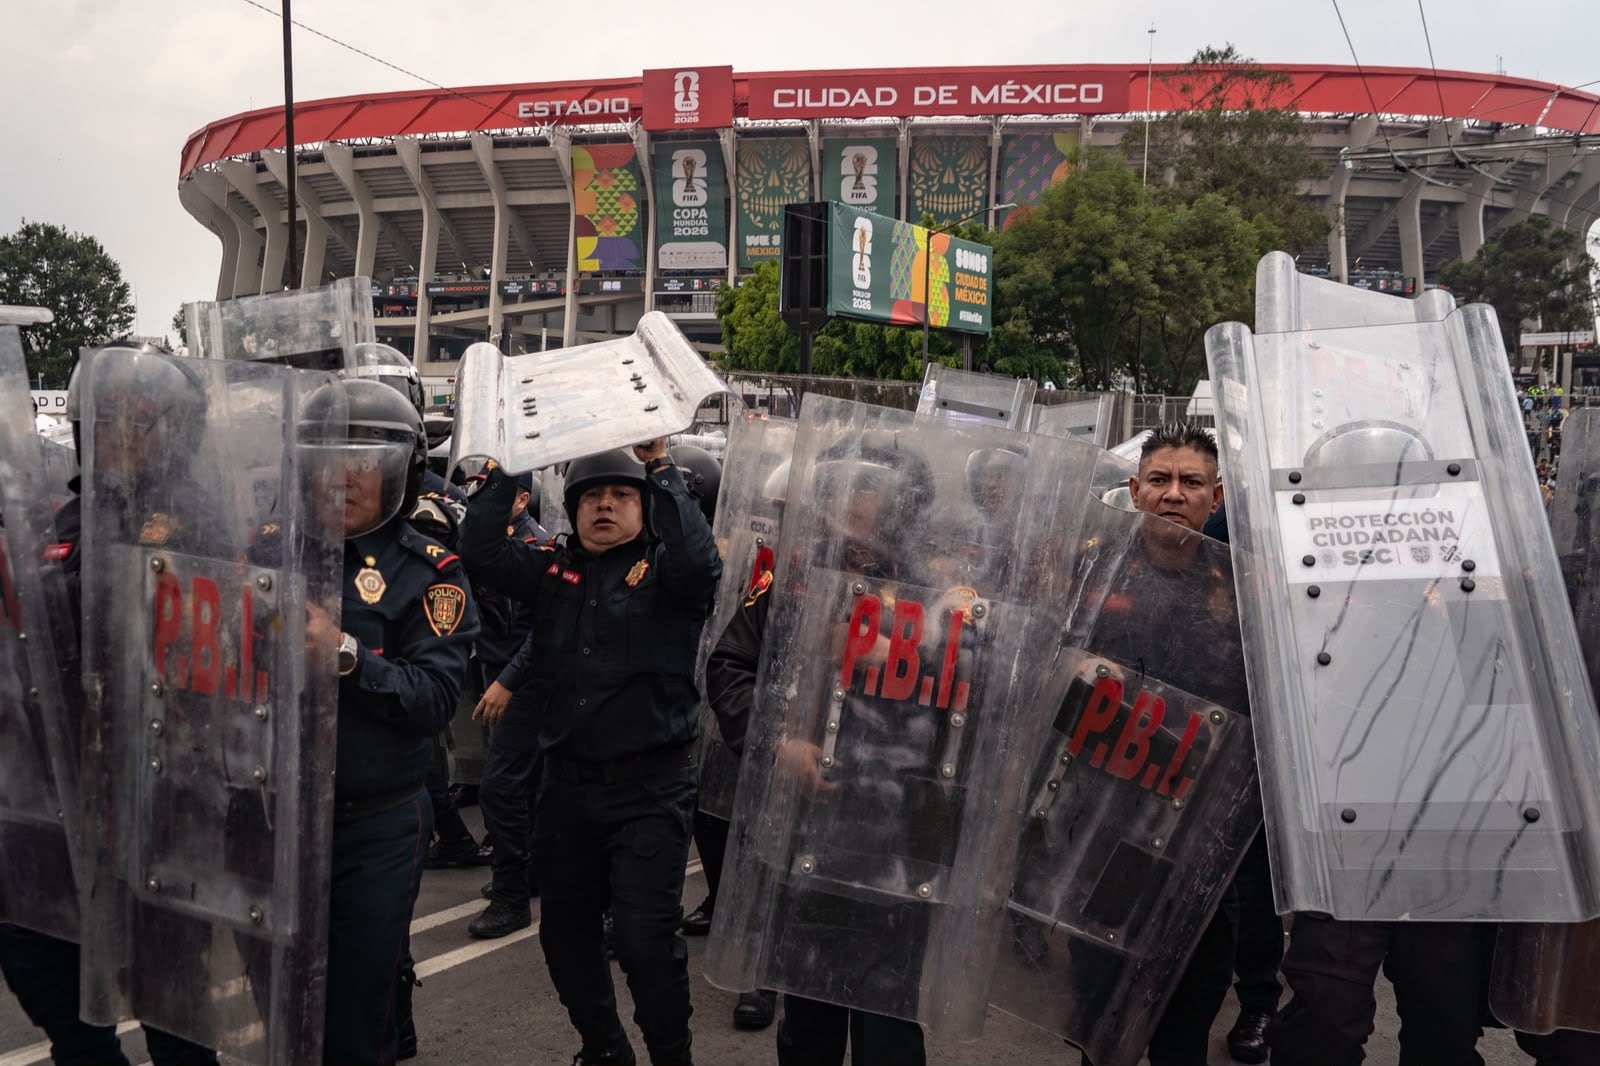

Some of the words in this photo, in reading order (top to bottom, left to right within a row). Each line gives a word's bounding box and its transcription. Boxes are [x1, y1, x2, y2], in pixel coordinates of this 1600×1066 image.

[773, 86, 897, 108] CIUDAD
[914, 86, 958, 106] DE
[970, 80, 1104, 104] MÉXICO
[518, 98, 630, 118] ESTADIO
[673, 208, 708, 219] COPA
[674, 227, 709, 236] 2026
[746, 248, 780, 256] MEXICO
[955, 272, 979, 289] CIUDAD
[955, 286, 987, 305] MÉXICO
[1310, 508, 1455, 530] PROTECCIÓN
[1312, 527, 1460, 548] CIUDADANA
[1342, 549, 1394, 566] SSC
[840, 594, 970, 711] P.B.I.
[1068, 678, 1204, 799] P.B.I.
